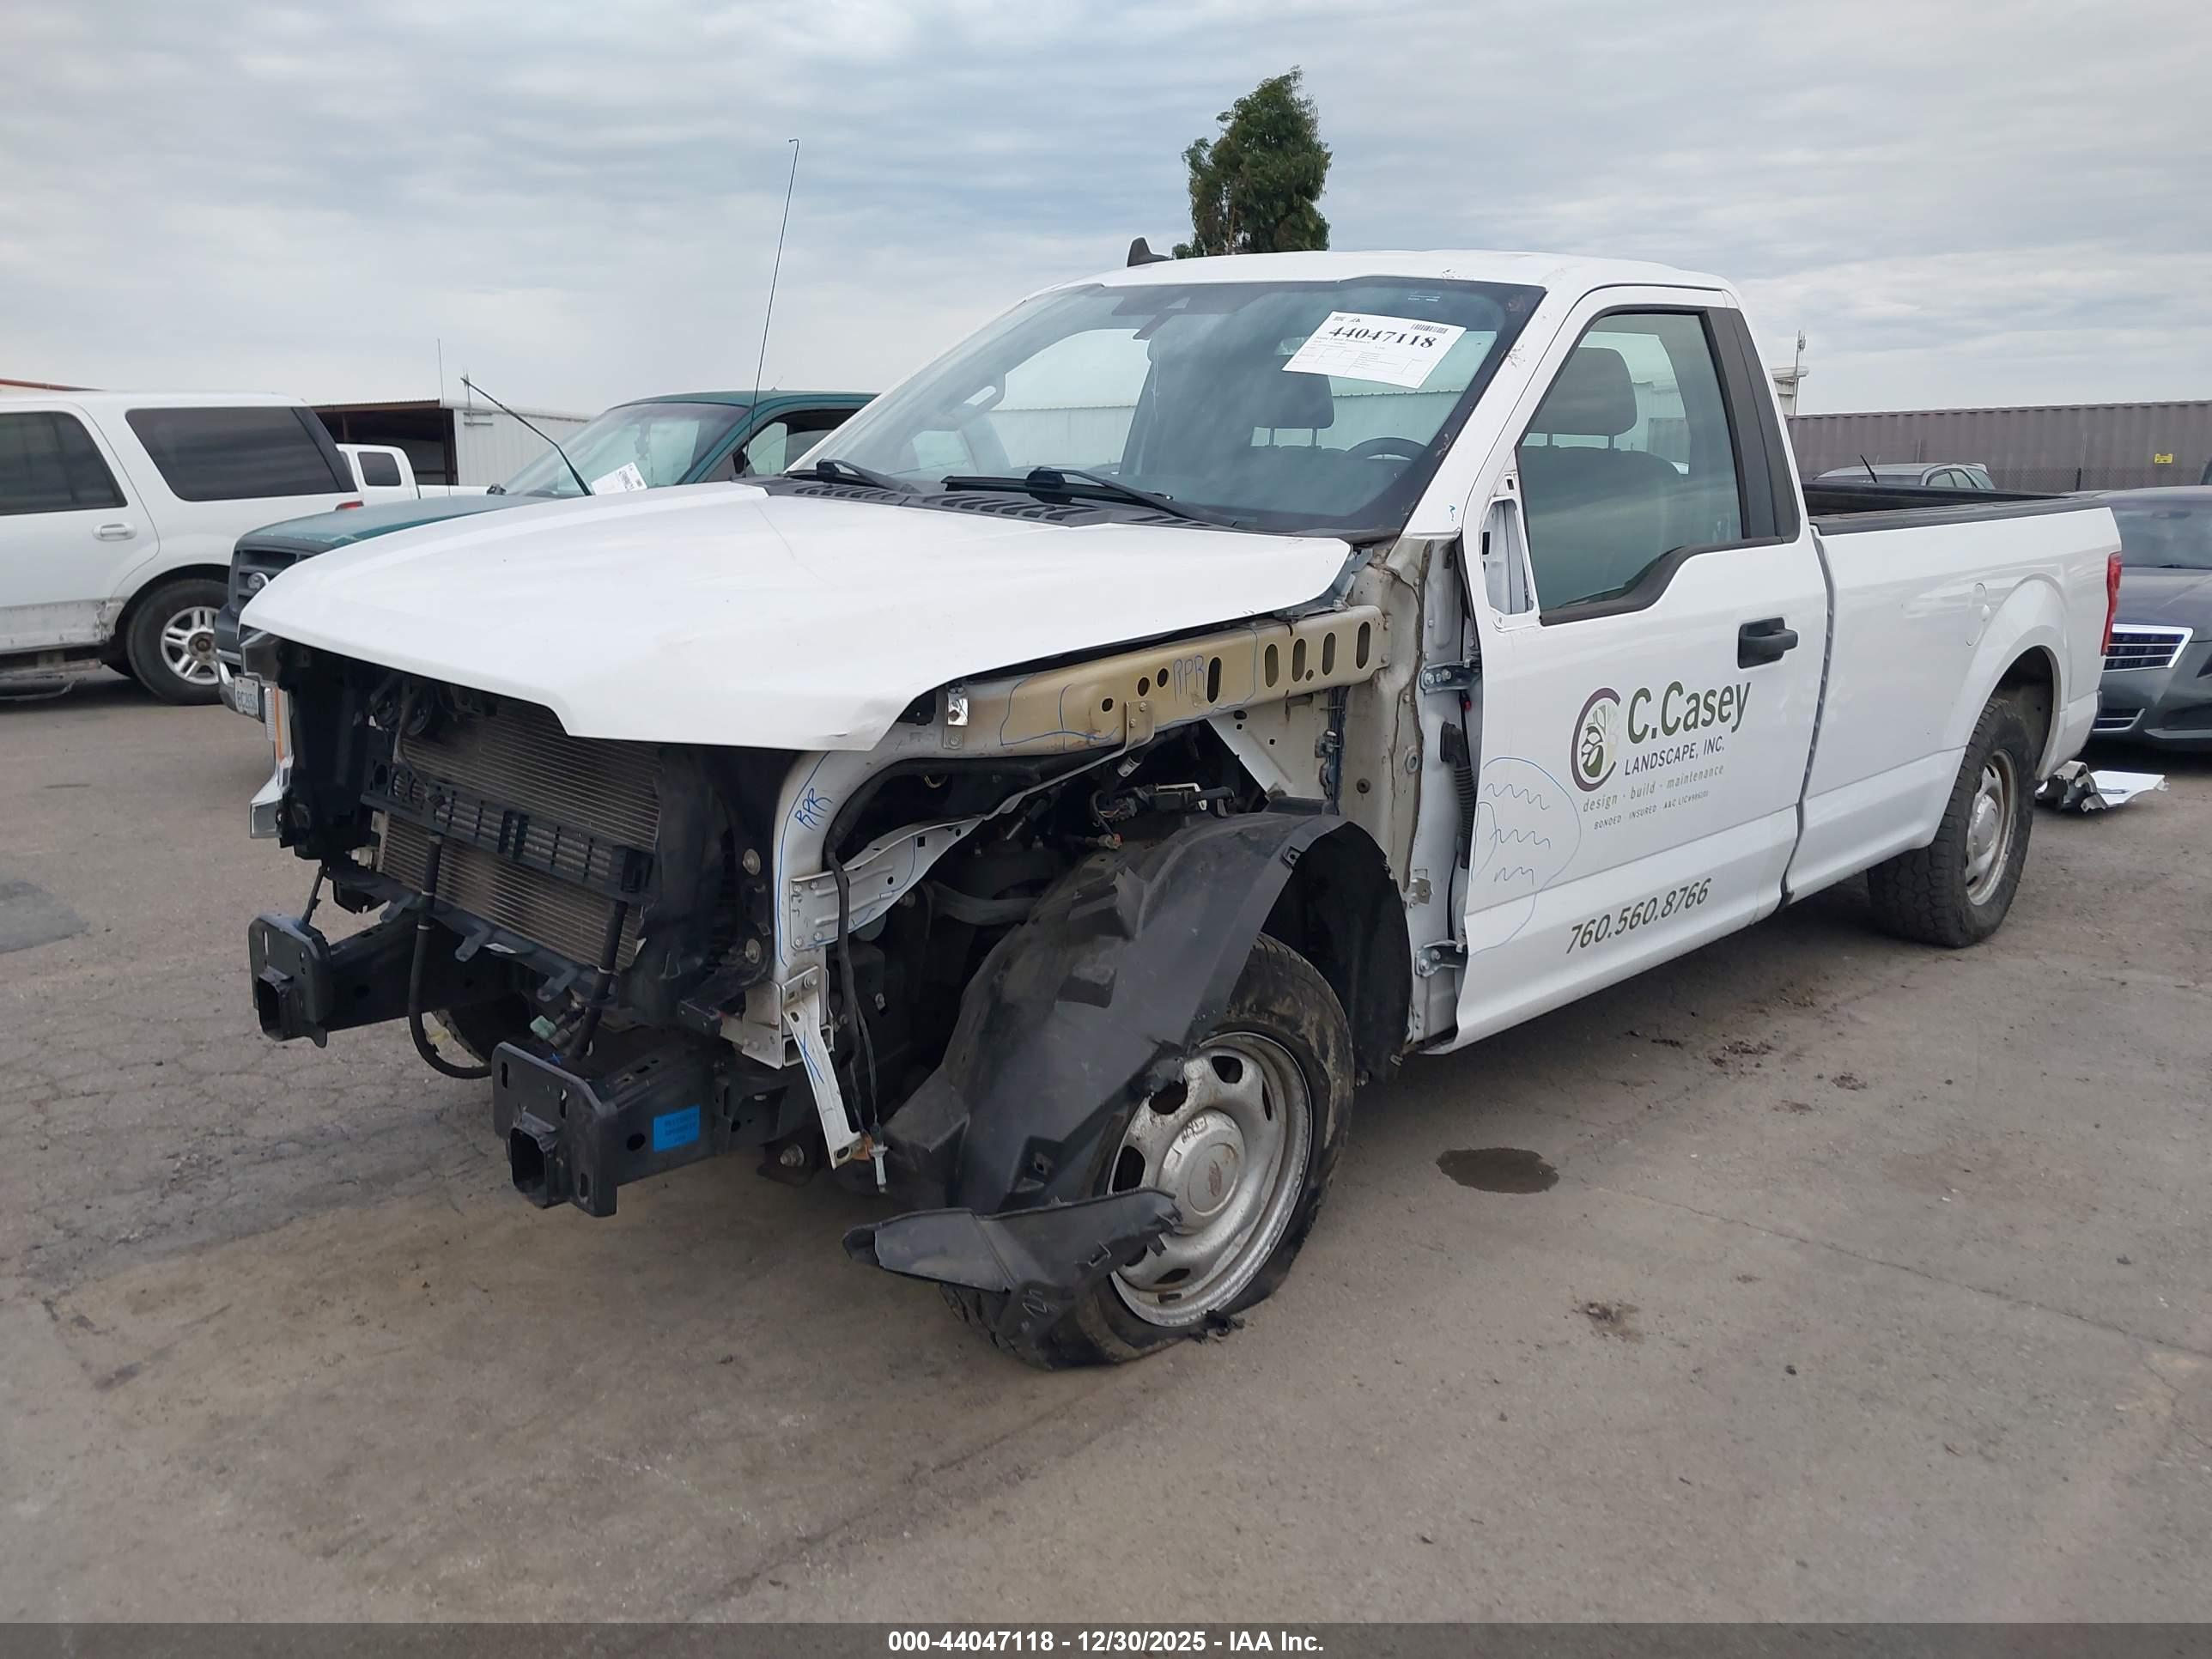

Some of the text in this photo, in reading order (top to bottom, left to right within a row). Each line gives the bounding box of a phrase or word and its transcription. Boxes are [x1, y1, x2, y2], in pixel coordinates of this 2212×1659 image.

[1328, 325, 1437, 349] 44047118
[1628, 681, 1751, 744] C.Casey
[1625, 735, 1725, 776] LANDSCAPE, INC.
[1583, 765, 1724, 812] design build maintenance
[1594, 814, 1622, 830] BONDED
[1628, 805, 1657, 819] INSURED
[1566, 878, 1711, 954] 760.560.8766
